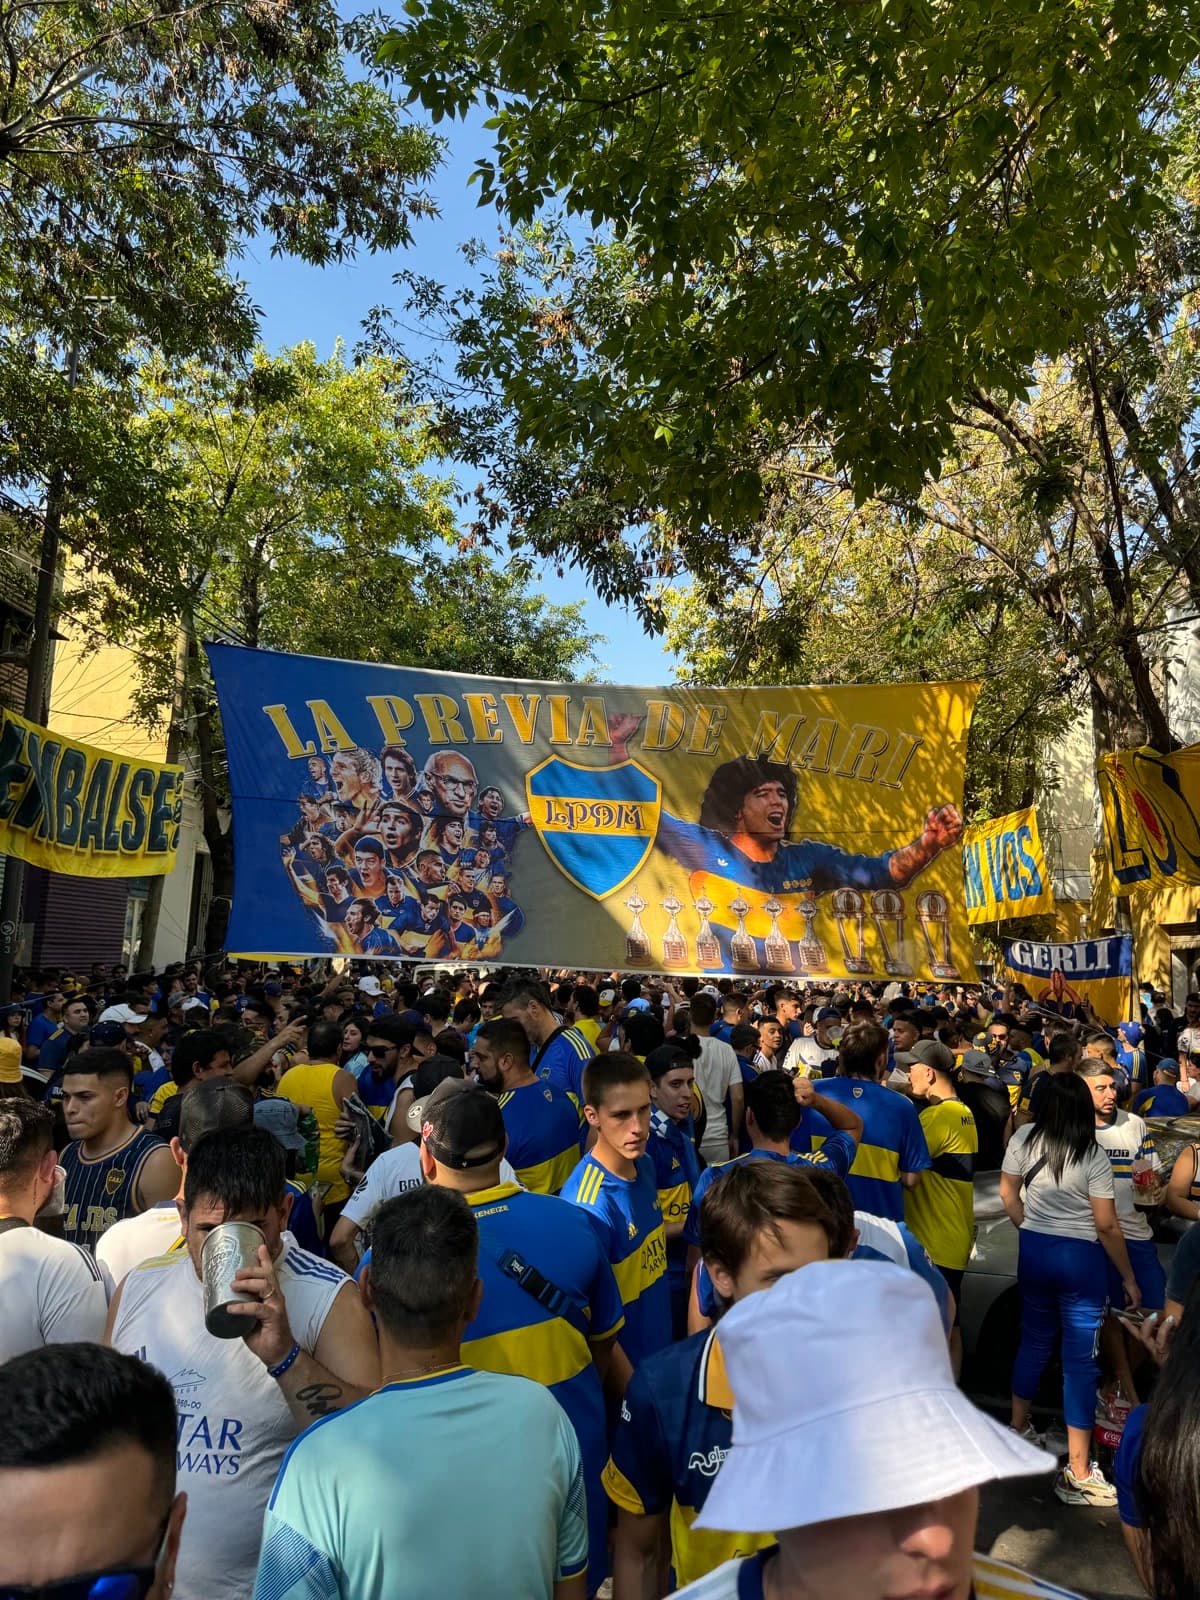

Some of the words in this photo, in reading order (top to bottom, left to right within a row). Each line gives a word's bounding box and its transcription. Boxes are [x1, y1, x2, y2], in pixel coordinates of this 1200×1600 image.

[262, 700, 358, 760] LA
[366, 693, 613, 747] PREVIA
[640, 700, 728, 757] DE
[746, 710, 925, 789] MARI
[986, 825, 1043, 903] VOS
[1011, 939, 1112, 972] GERLI
